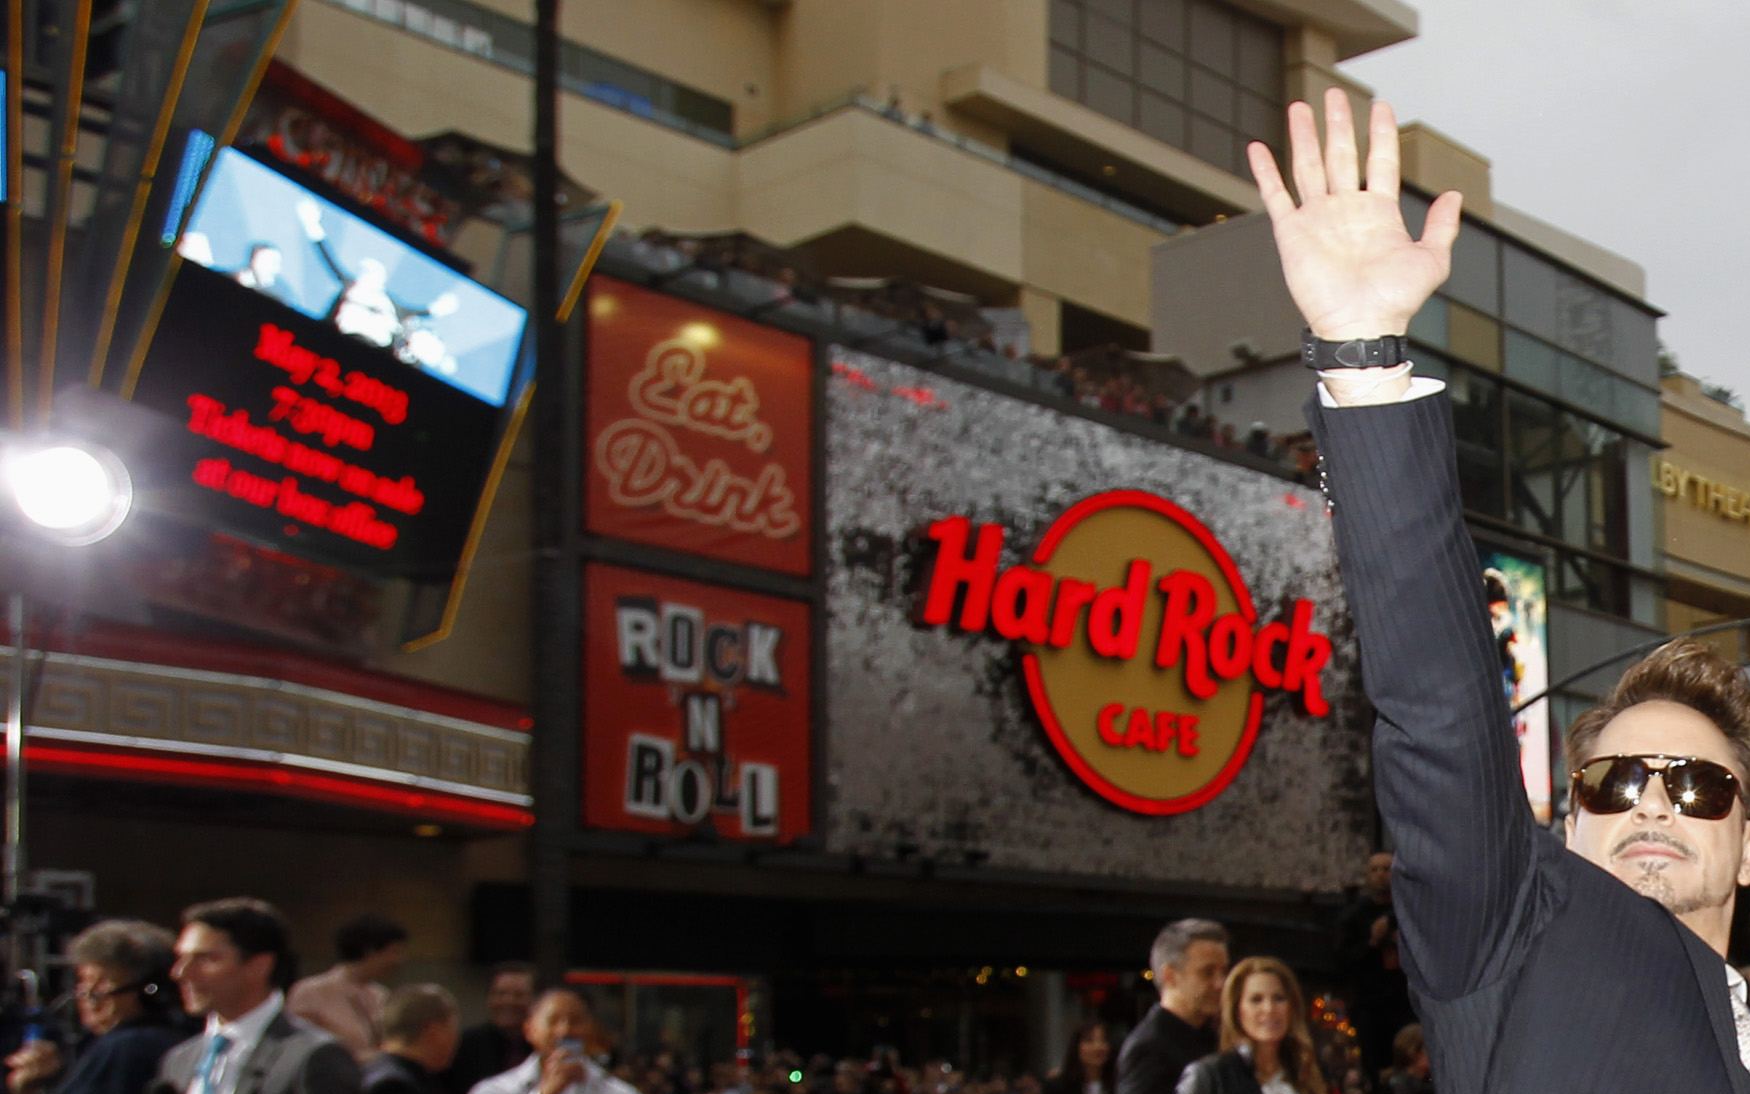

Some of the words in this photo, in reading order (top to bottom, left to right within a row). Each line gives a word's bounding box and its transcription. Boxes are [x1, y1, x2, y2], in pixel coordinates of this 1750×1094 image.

[596, 418, 800, 538] Drink
[616, 605, 781, 684] ROCK
[923, 515, 1152, 660] Hard
[1155, 569, 1332, 718] Rock
[1098, 702, 1201, 758] CAFE
[628, 737, 779, 835] ROLL
